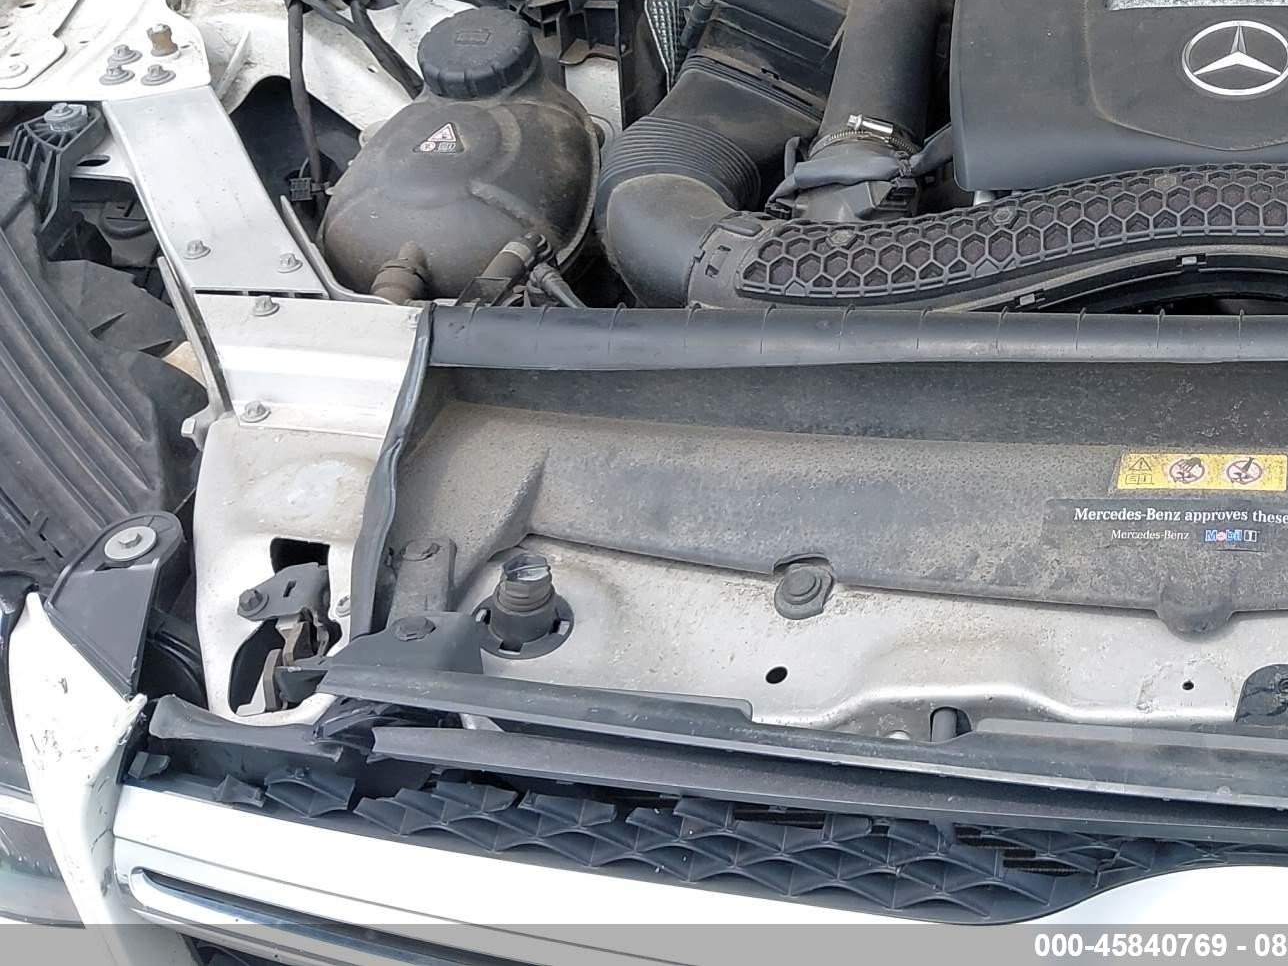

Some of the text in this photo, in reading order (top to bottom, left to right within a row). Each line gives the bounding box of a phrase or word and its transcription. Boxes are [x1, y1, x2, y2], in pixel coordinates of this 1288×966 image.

[1073, 508, 1181, 522] Mercedes-Benz
[1184, 510, 1249, 524] approves
[1111, 529, 1190, 541] Mercedes-Benz
[1204, 529, 1243, 542] Mobil
